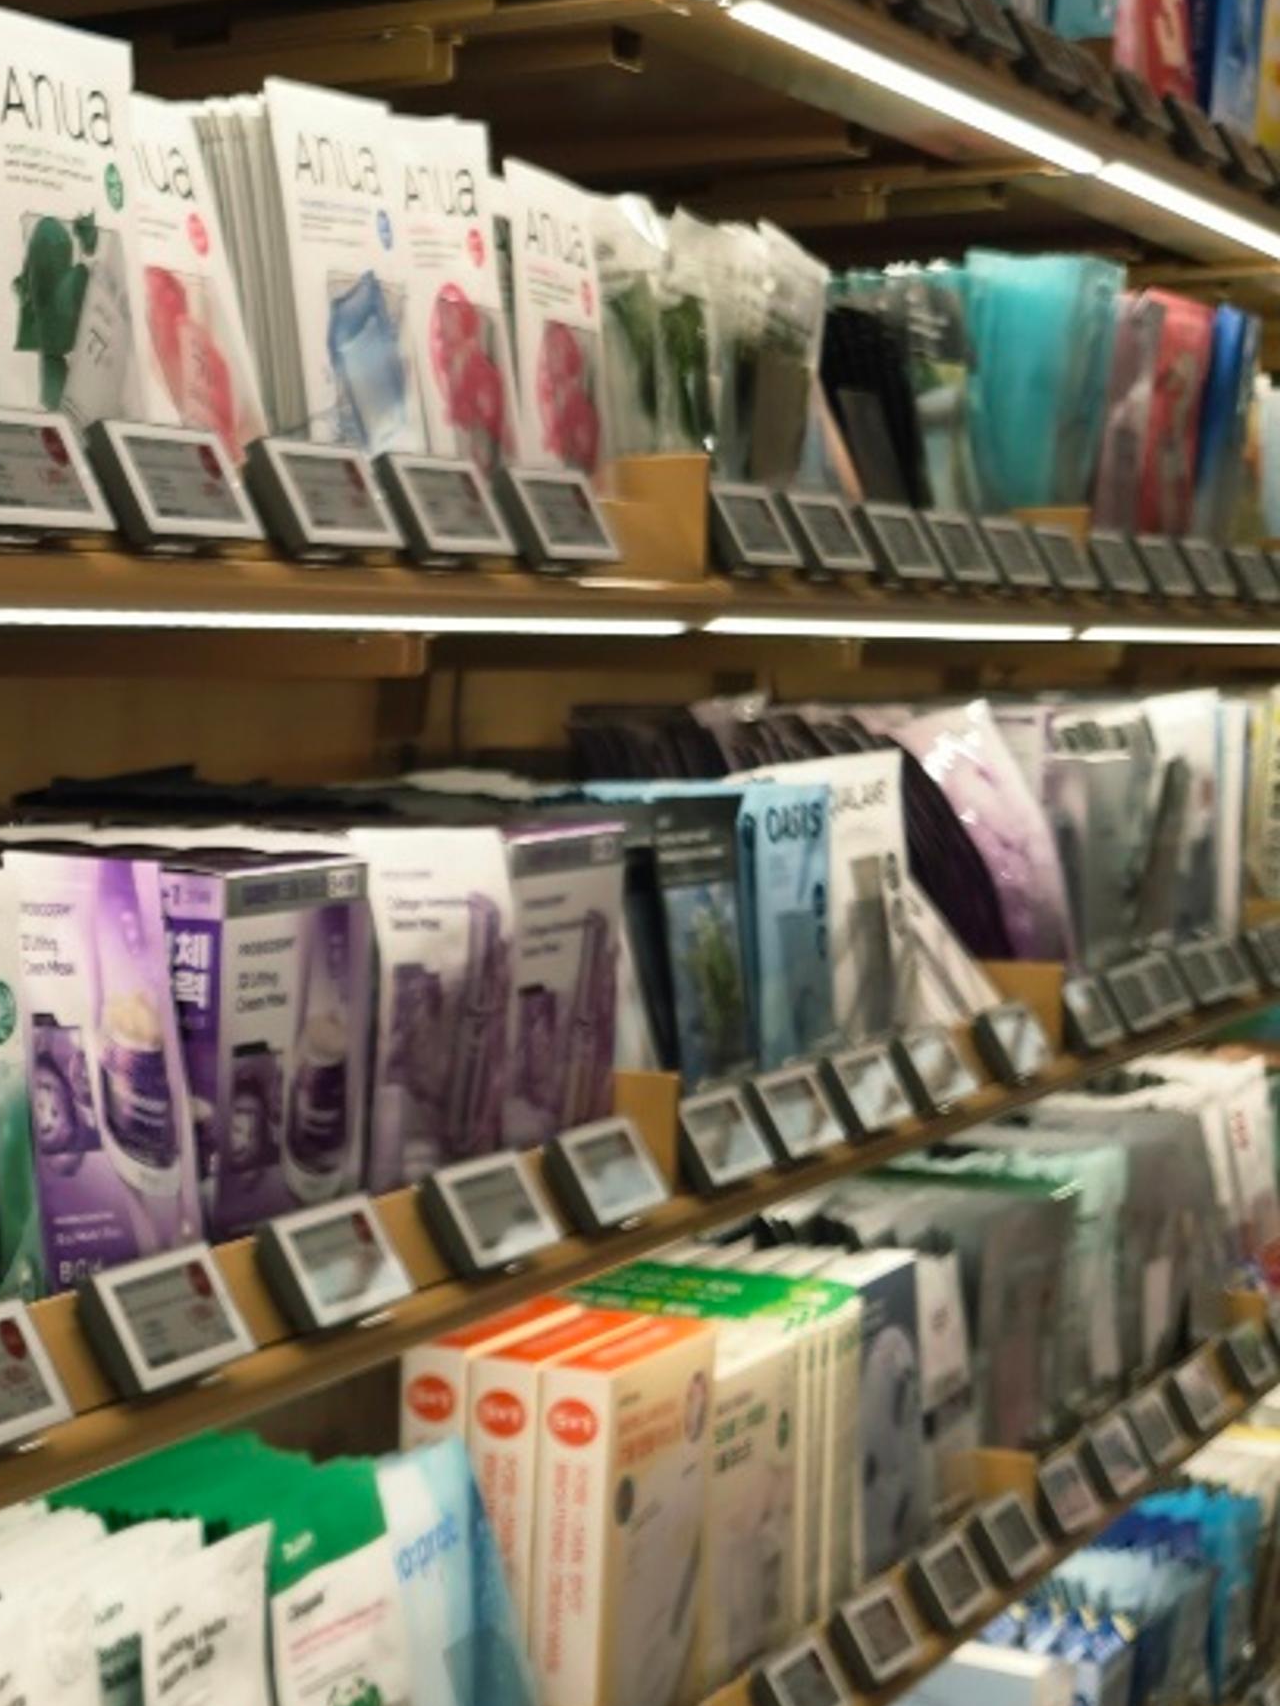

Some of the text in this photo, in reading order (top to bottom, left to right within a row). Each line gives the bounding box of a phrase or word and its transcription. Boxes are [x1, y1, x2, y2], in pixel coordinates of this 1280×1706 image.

[0, 63, 117, 153] Anua
[292, 129, 384, 199] Anua
[402, 162, 479, 220] Anua
[525, 204, 591, 271] Anua
